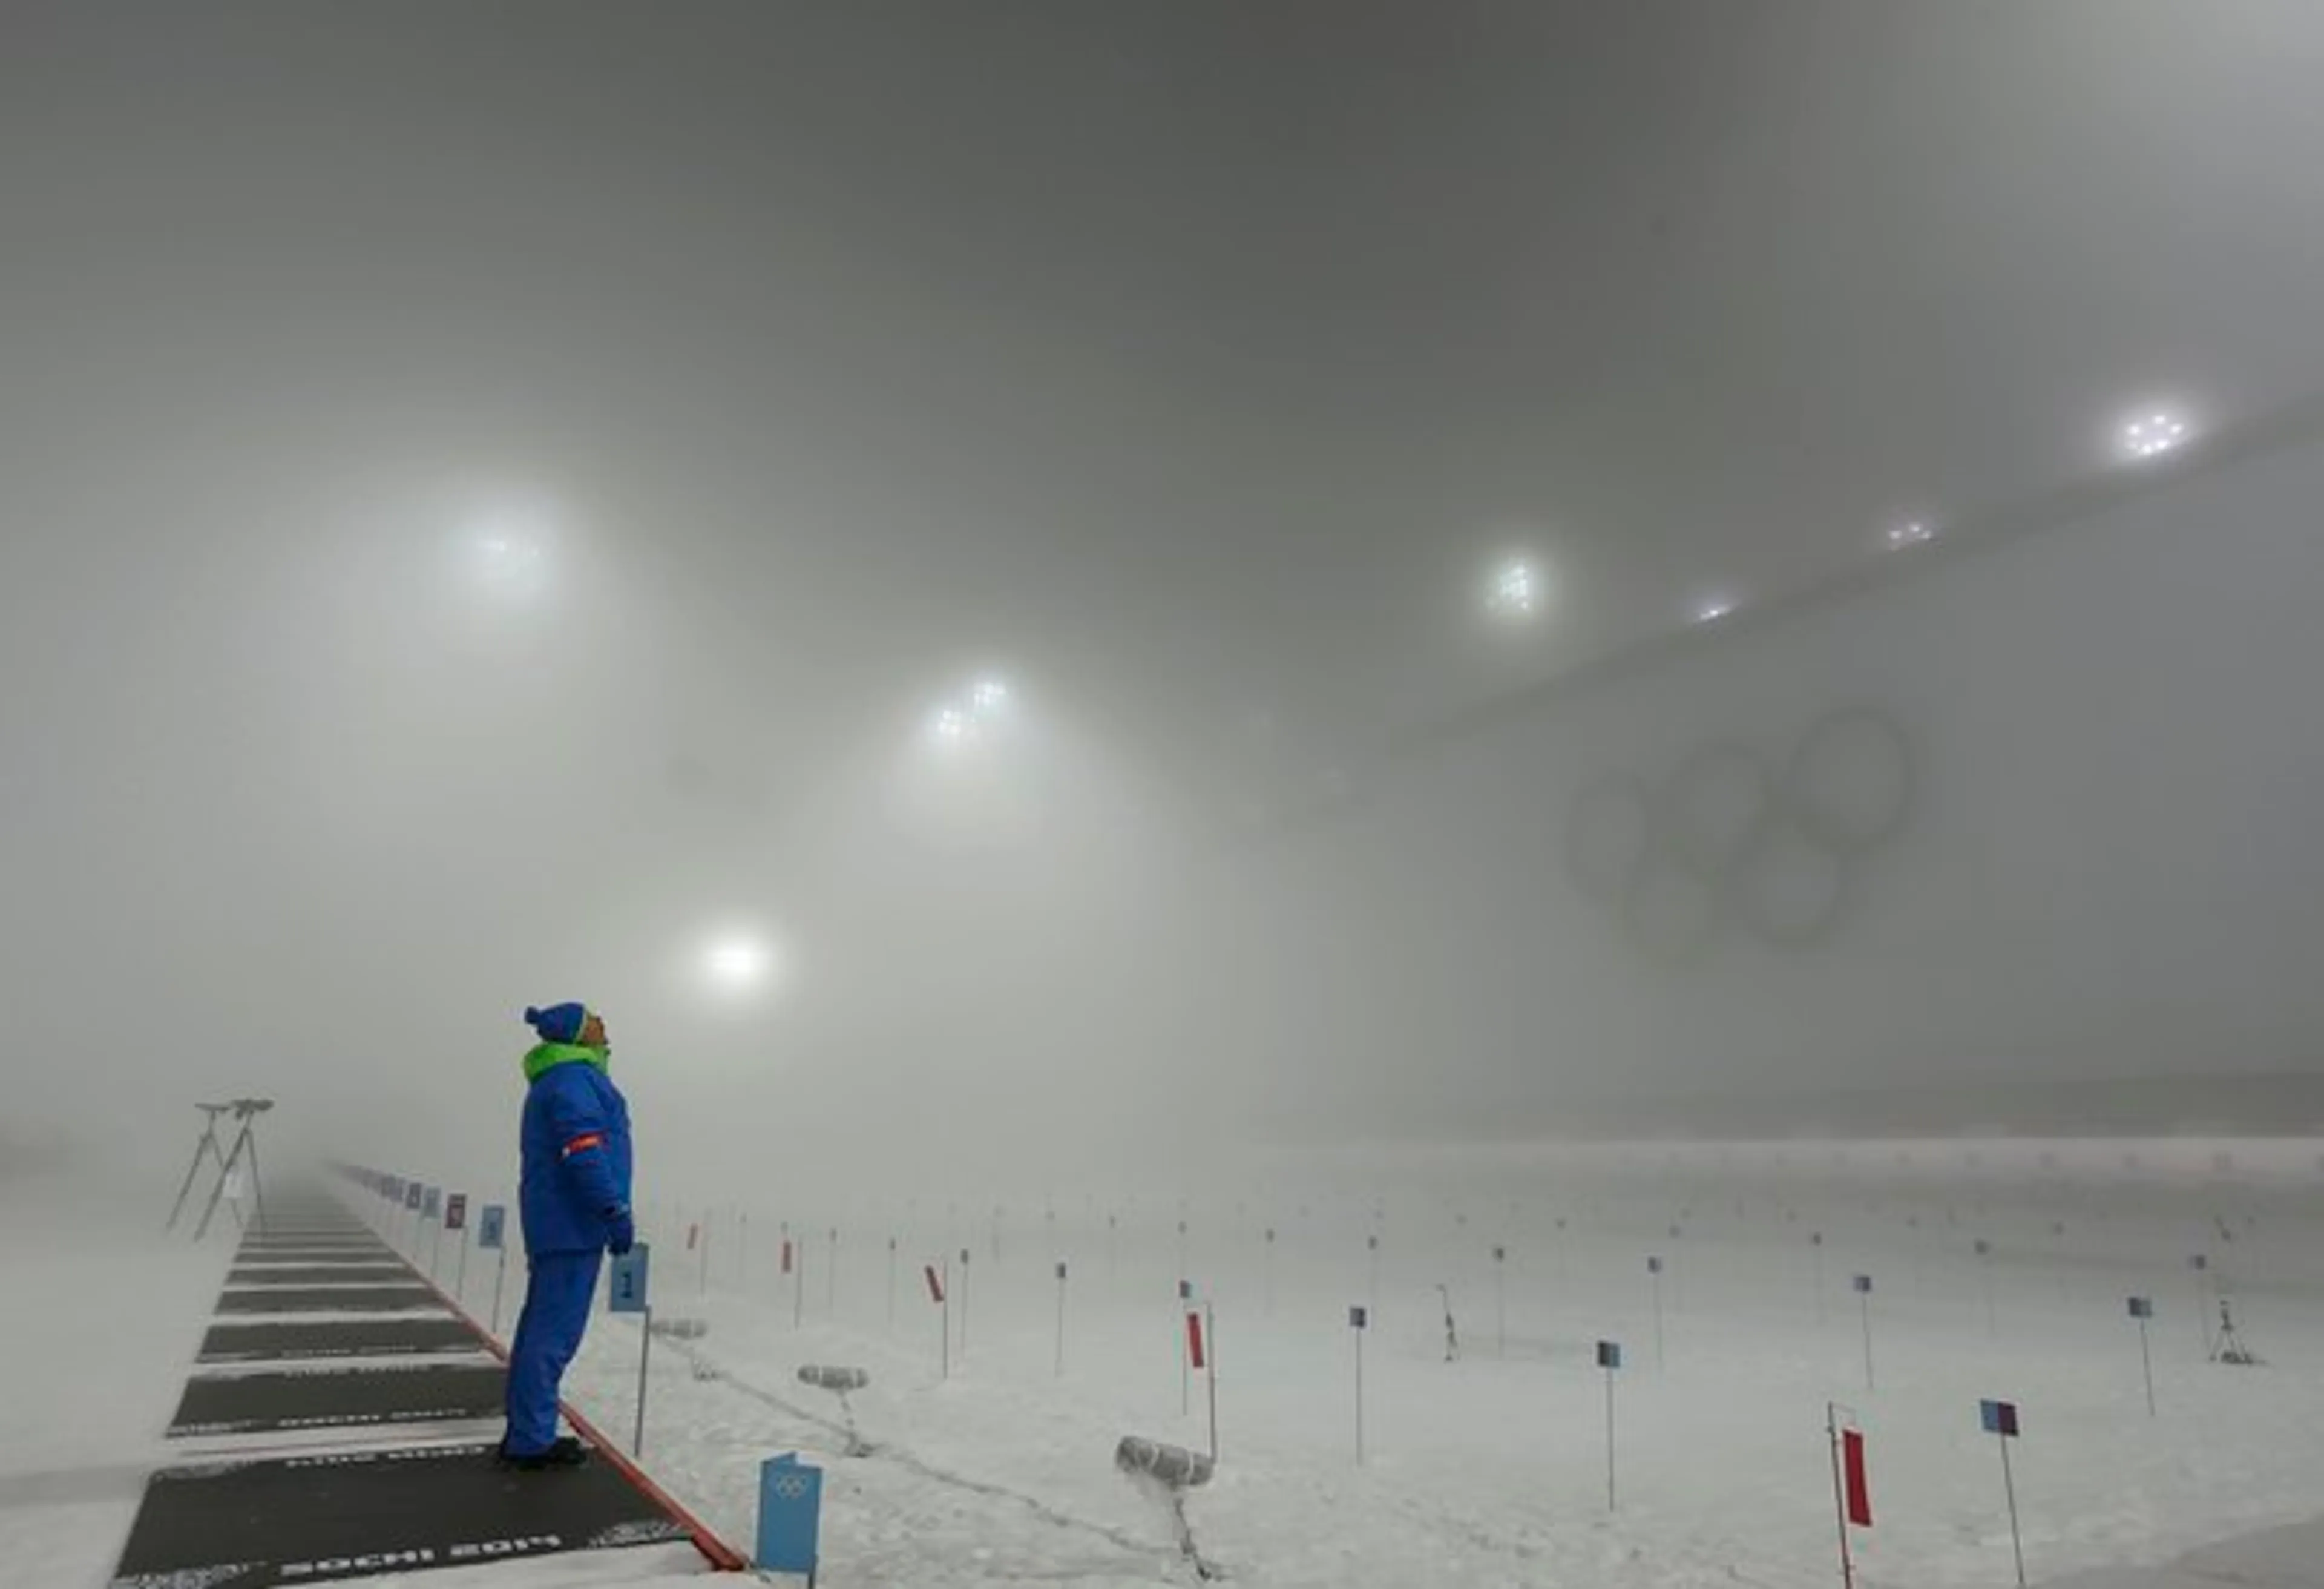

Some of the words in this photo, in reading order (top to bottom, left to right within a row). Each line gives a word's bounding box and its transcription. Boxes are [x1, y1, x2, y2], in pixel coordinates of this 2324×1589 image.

[620, 1271, 632, 1299] 1
[281, 1548, 435, 1576] SOCHI
[450, 1534, 562, 1557] 2014
